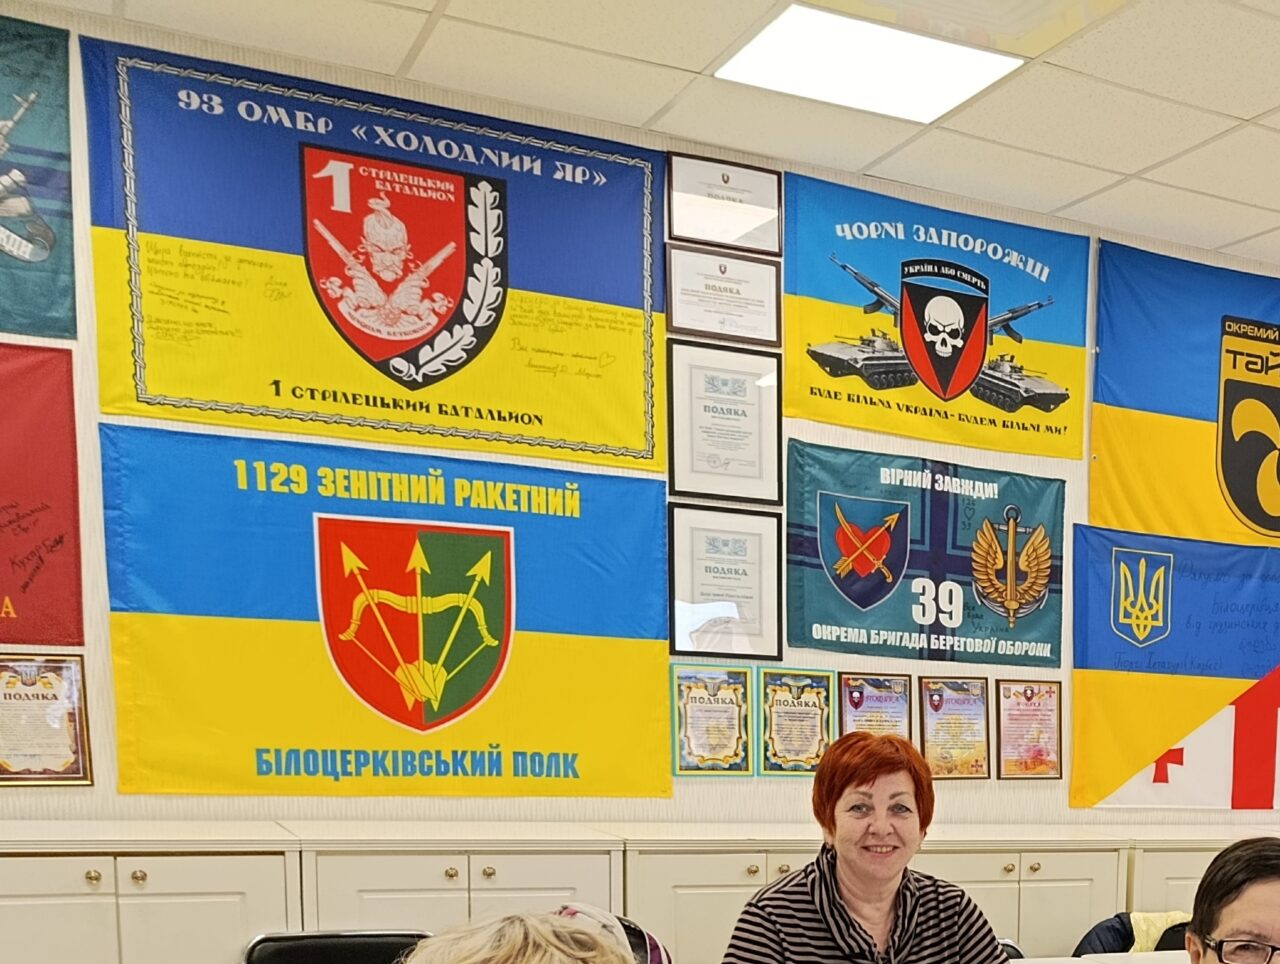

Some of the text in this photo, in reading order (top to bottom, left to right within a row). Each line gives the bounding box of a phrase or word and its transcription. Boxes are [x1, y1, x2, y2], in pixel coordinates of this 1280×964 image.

[177, 89, 224, 115] 93
[312, 159, 354, 213] 1
[835, 221, 1050, 283] ЧОРНІ ЗАПОРОЖЦІ
[704, 283, 741, 296] ПОДЯКА
[904, 262, 986, 289] УКРАЇНА АБО СМЕРТЬ
[1225, 321, 1279, 340] ОКРЕМИЙ
[269, 379, 543, 426] 1 СТРІЛЕЦЬКИЙ БАТАЛЬЙОН
[703, 404, 748, 418] ПОДЯКА
[809, 386, 842, 400] БУДЕ
[847, 393, 892, 409] ВІЛЬНА
[958, 412, 998, 427] БУДЕМ
[1002, 419, 1040, 432] ВІЛЬНІ
[1044, 424, 1068, 436] МИ!
[233, 459, 581, 518] 1129 ЗЕНІТНИЙ РАКЕТНИЙ
[880, 467, 998, 499] ВІРНИЙ ЗАВЖДИ!
[704, 565, 748, 577] ПОДЯКА
[911, 577, 964, 628] 39
[811, 623, 1052, 658] ОКРЕМА БРИГАДА БЕРЕГОВОЇ ОБОРОНИ
[3, 692, 59, 701] ПОДЯКА
[690, 696, 735, 706] ПОДЯКА
[775, 699, 818, 708] ПОДЯКА
[255, 743, 580, 782] БІЛОЦЕРКІВСЬКИЙ ПОЛК
